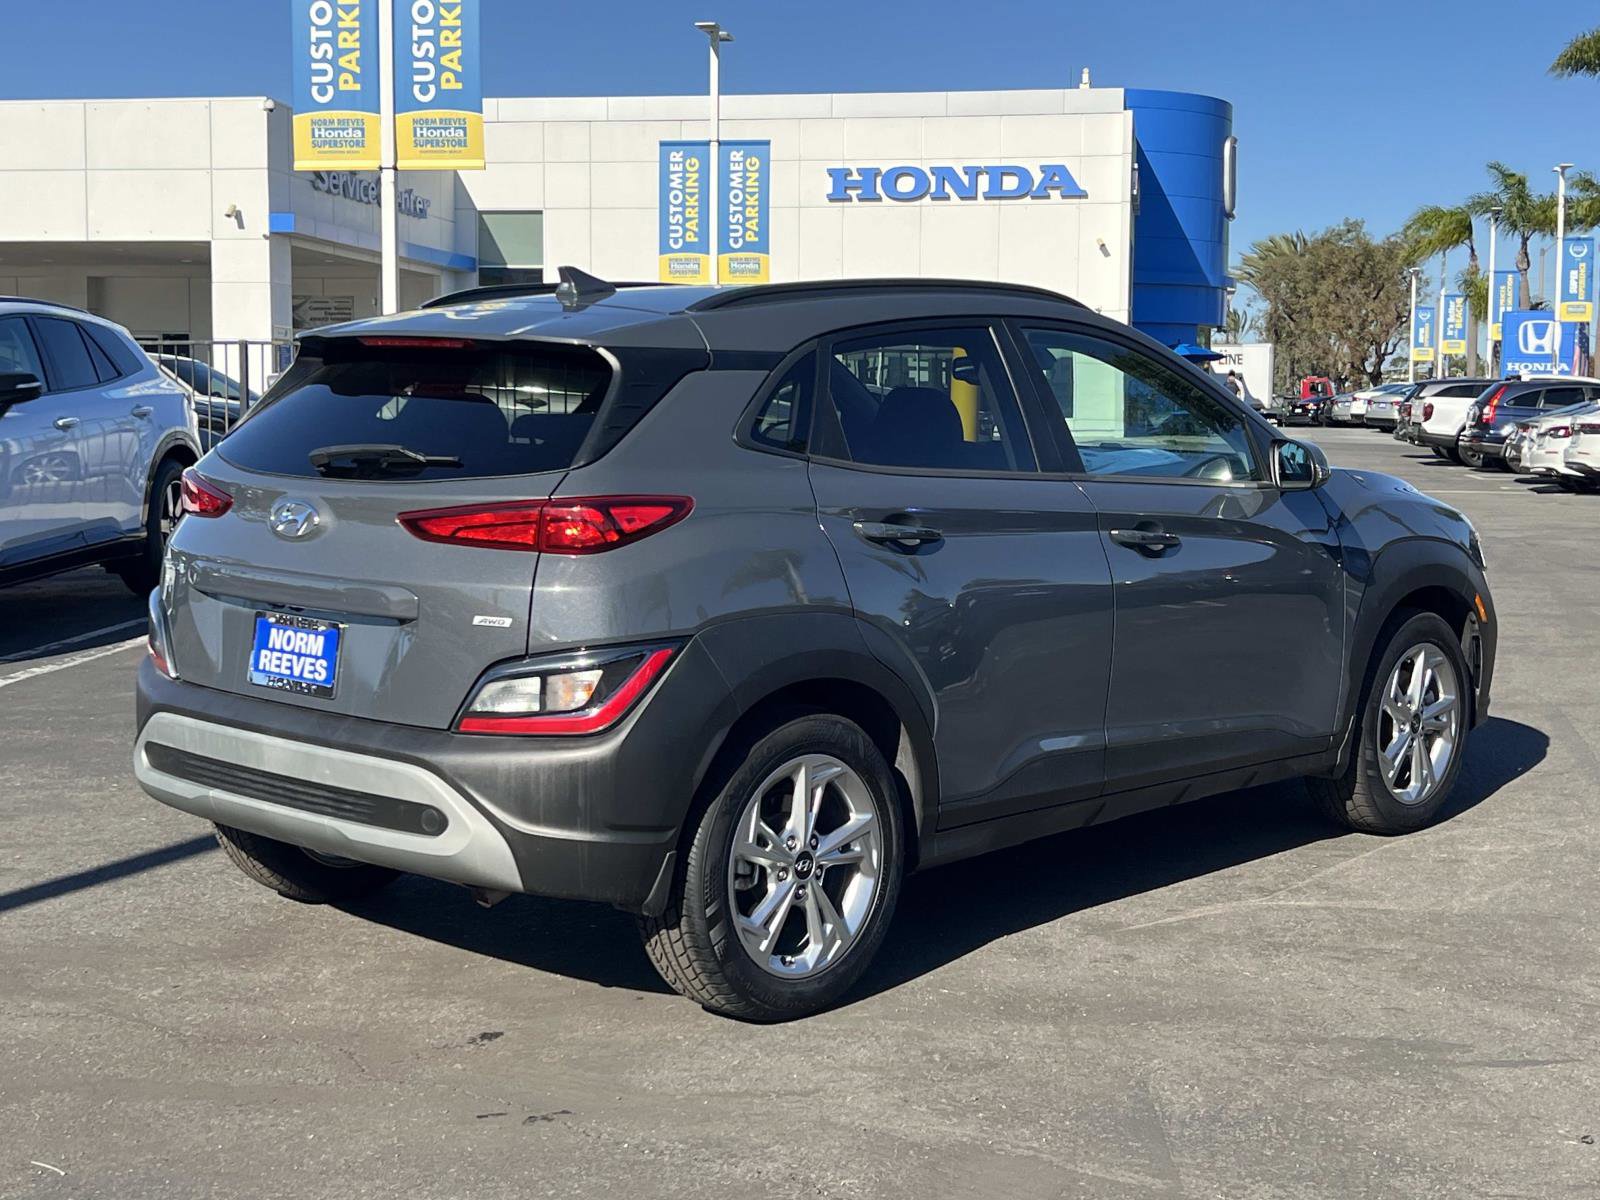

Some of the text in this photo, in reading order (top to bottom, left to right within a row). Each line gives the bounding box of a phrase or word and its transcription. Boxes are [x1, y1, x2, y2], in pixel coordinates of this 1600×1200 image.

[309, 0, 334, 103] CUSTO
[411, 0, 436, 103] CUSTO
[311, 118, 365, 127] NORM REEVES
[314, 128, 362, 138] Honda
[412, 117, 467, 126] NORM REEVES
[416, 127, 464, 138] Honda
[312, 139, 366, 149] SUPERSTORE
[413, 138, 468, 148] SUPERSTORE
[312, 170, 377, 206] Service
[669, 150, 683, 249] CUSTOMER
[685, 157, 699, 242] PARKING
[729, 150, 744, 249] CUSTOMER
[745, 156, 760, 242] PARKING
[826, 164, 1088, 202] HONDA
[268, 627, 324, 657] NORM
[258, 649, 328, 683] REEVES
